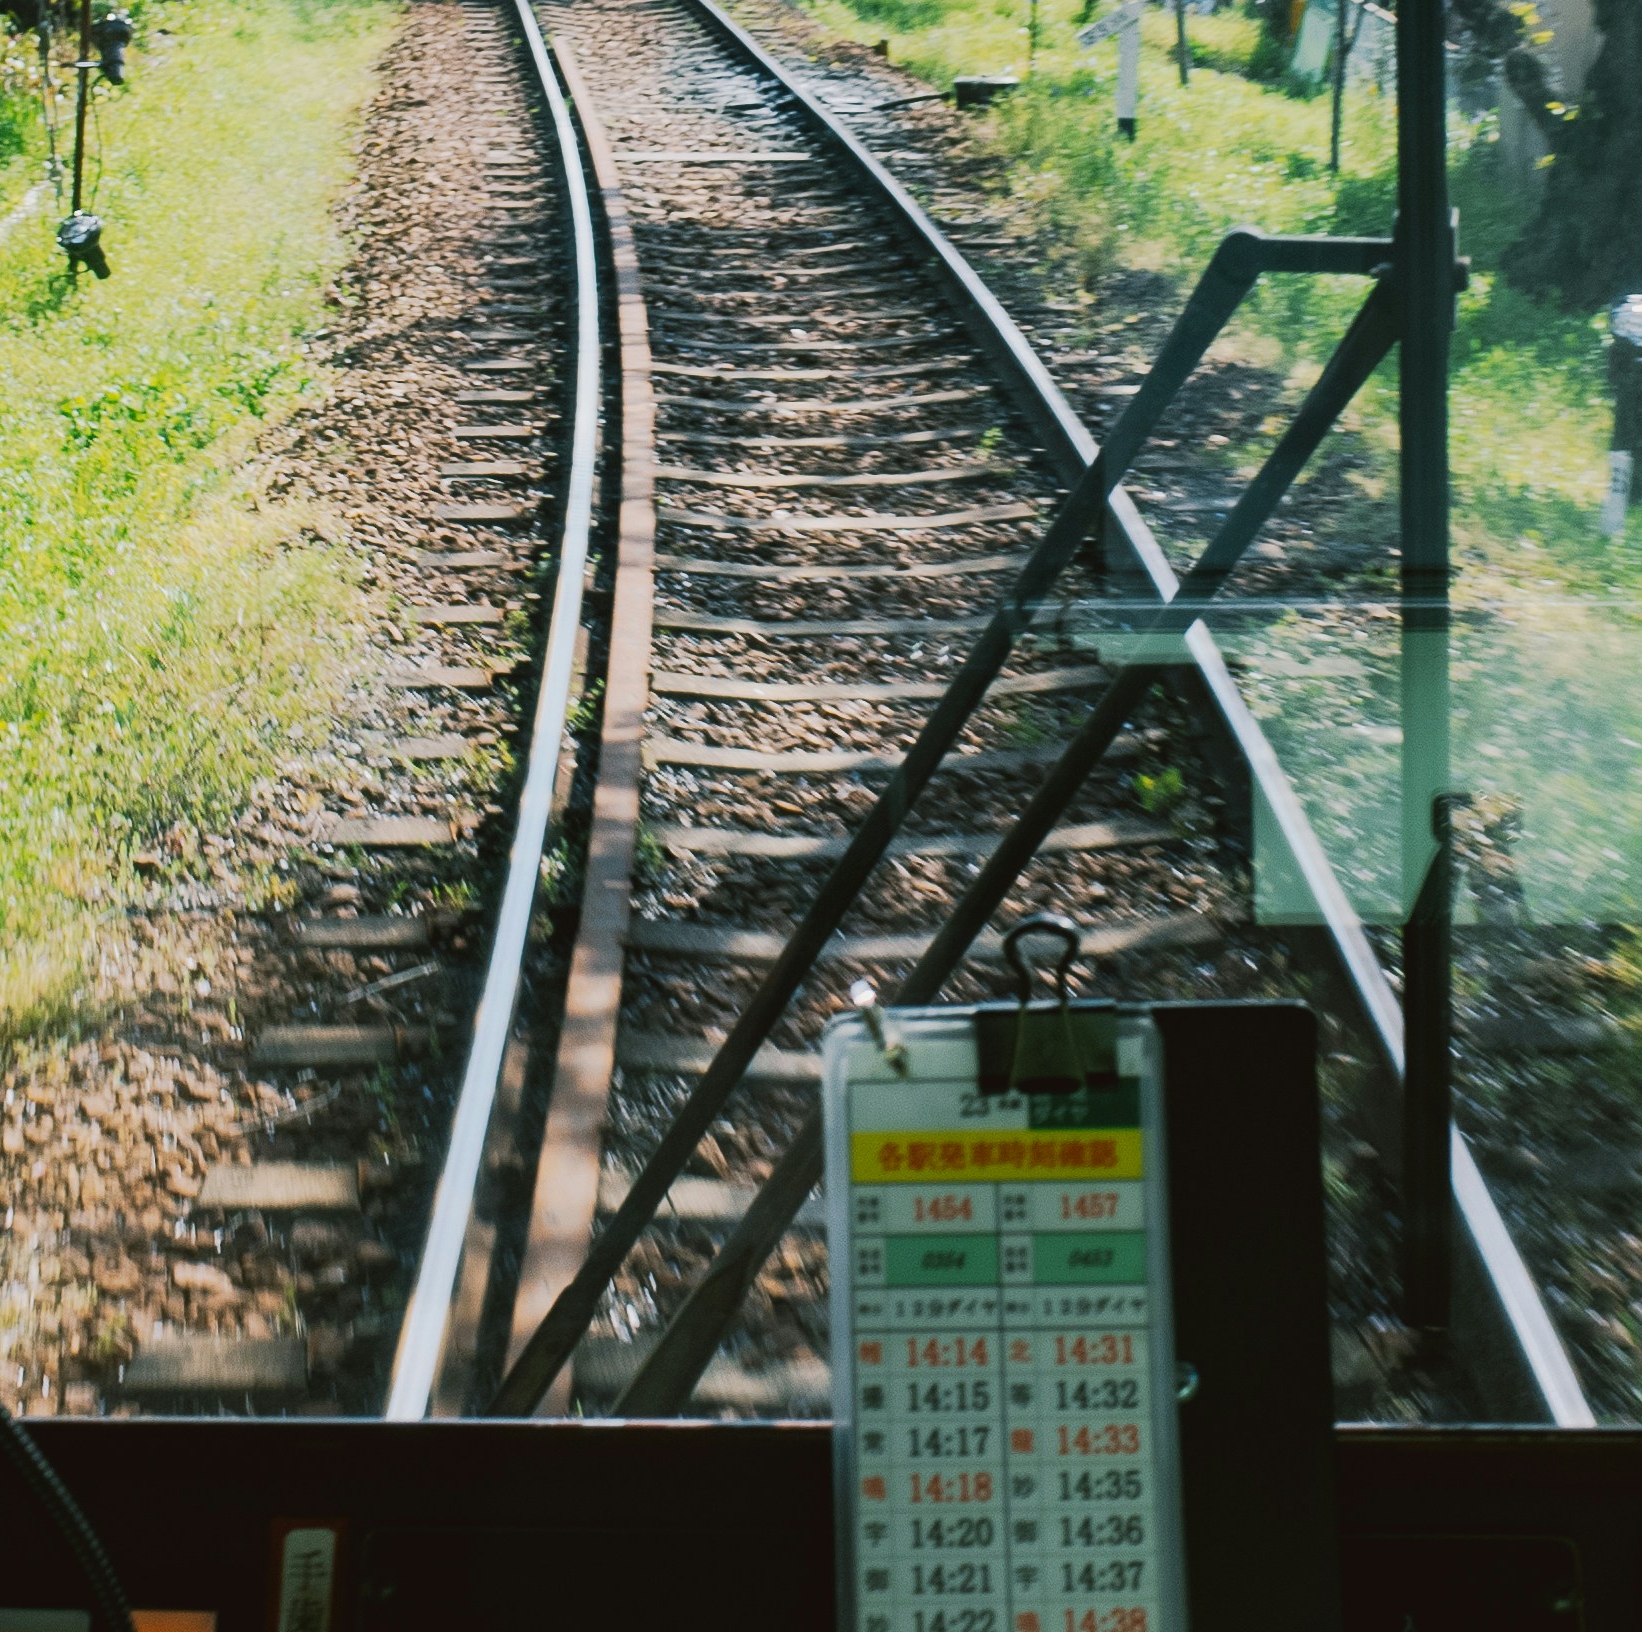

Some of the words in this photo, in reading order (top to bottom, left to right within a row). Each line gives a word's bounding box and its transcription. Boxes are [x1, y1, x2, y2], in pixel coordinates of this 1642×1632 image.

[915, 1195, 973, 1221] 1454
[1061, 1193, 1119, 1219] 1457
[907, 1337, 987, 1367] 14:14
[1056, 1334, 1133, 1365] 14:31
[908, 1380, 989, 1412] 14:15
[1057, 1379, 1138, 1410] 14:32
[910, 1426, 990, 1457] 14:17
[1058, 1424, 1140, 1455] 14:33
[911, 1472, 992, 1503] 14:18
[1060, 1469, 1142, 1501] 14:35
[912, 1517, 994, 1548] 14:20
[1061, 1515, 1144, 1546] 14:36
[913, 1563, 991, 1595] 14:21
[1063, 1560, 1144, 1592] 14:37
[914, 1609, 995, 1632] 14:22
